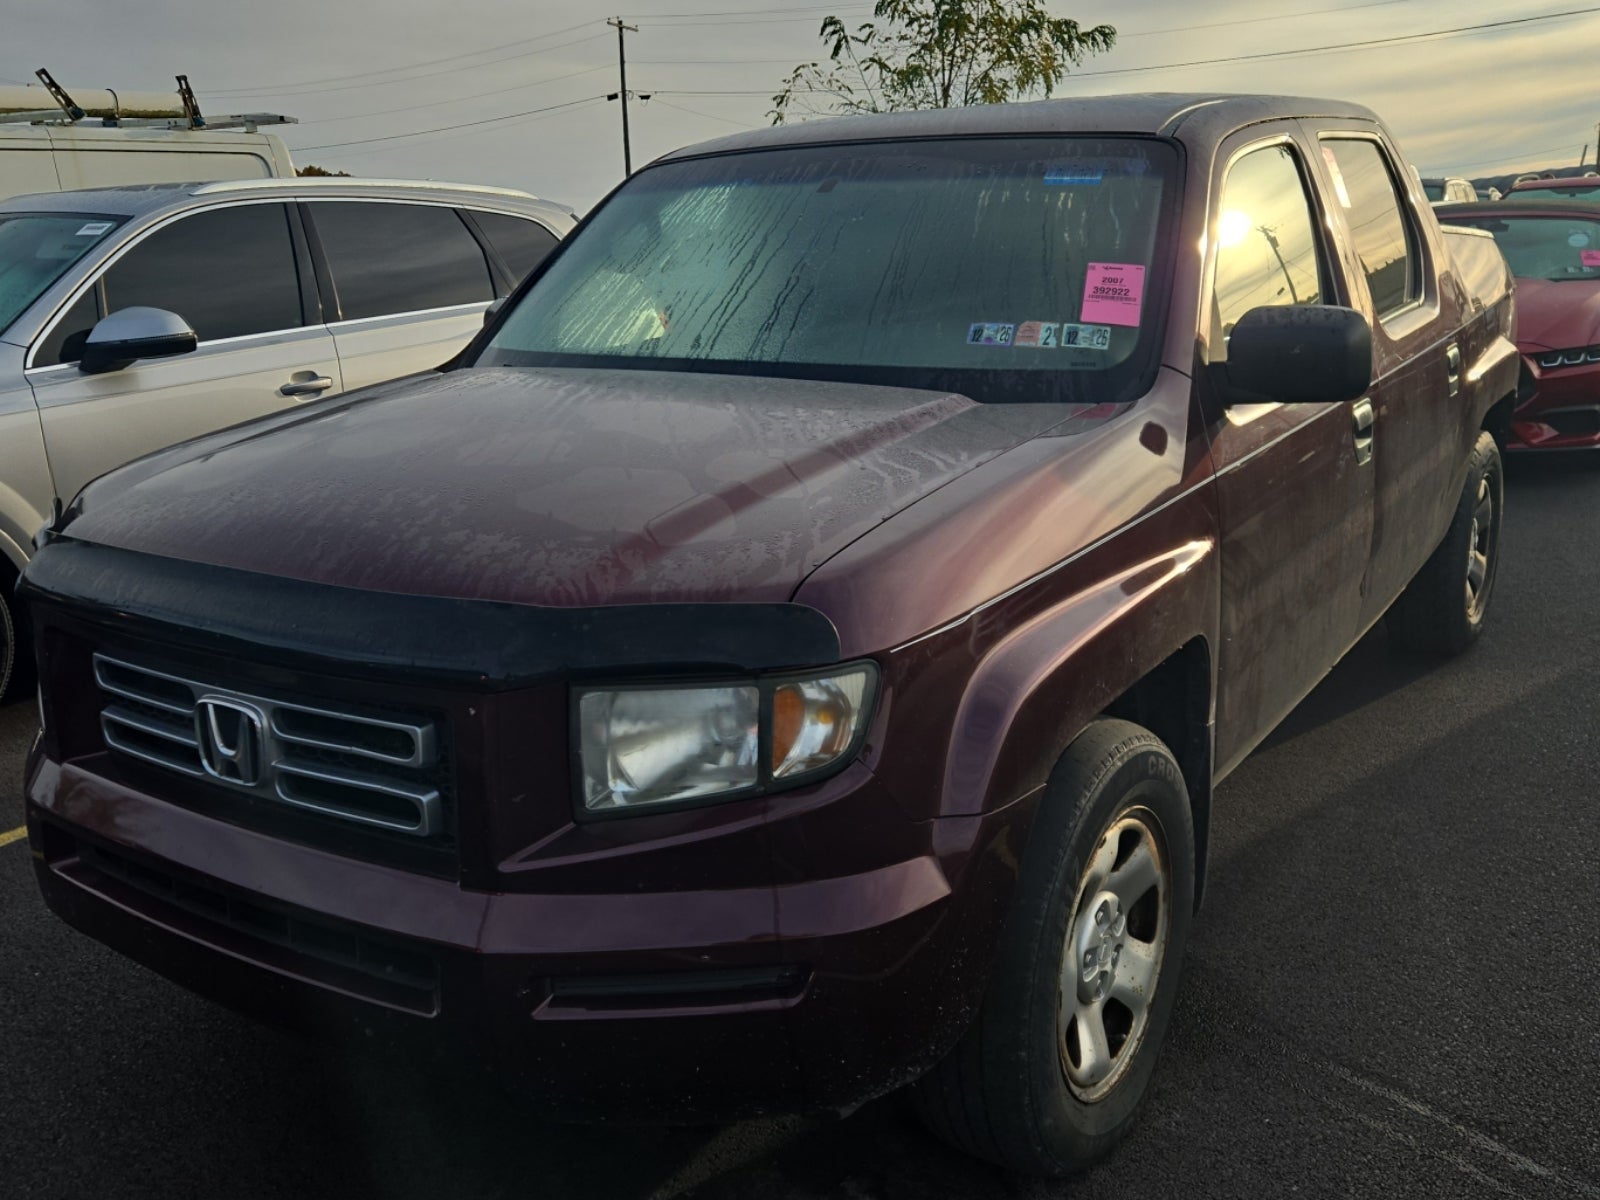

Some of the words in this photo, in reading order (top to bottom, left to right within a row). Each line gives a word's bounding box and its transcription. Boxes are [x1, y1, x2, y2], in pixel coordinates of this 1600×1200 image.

[1101, 276, 1124, 284] 2007
[1093, 286, 1130, 297] 392922
[971, 328, 984, 342] 12
[1067, 330, 1079, 345] 12
[1096, 329, 1108, 345] 26
